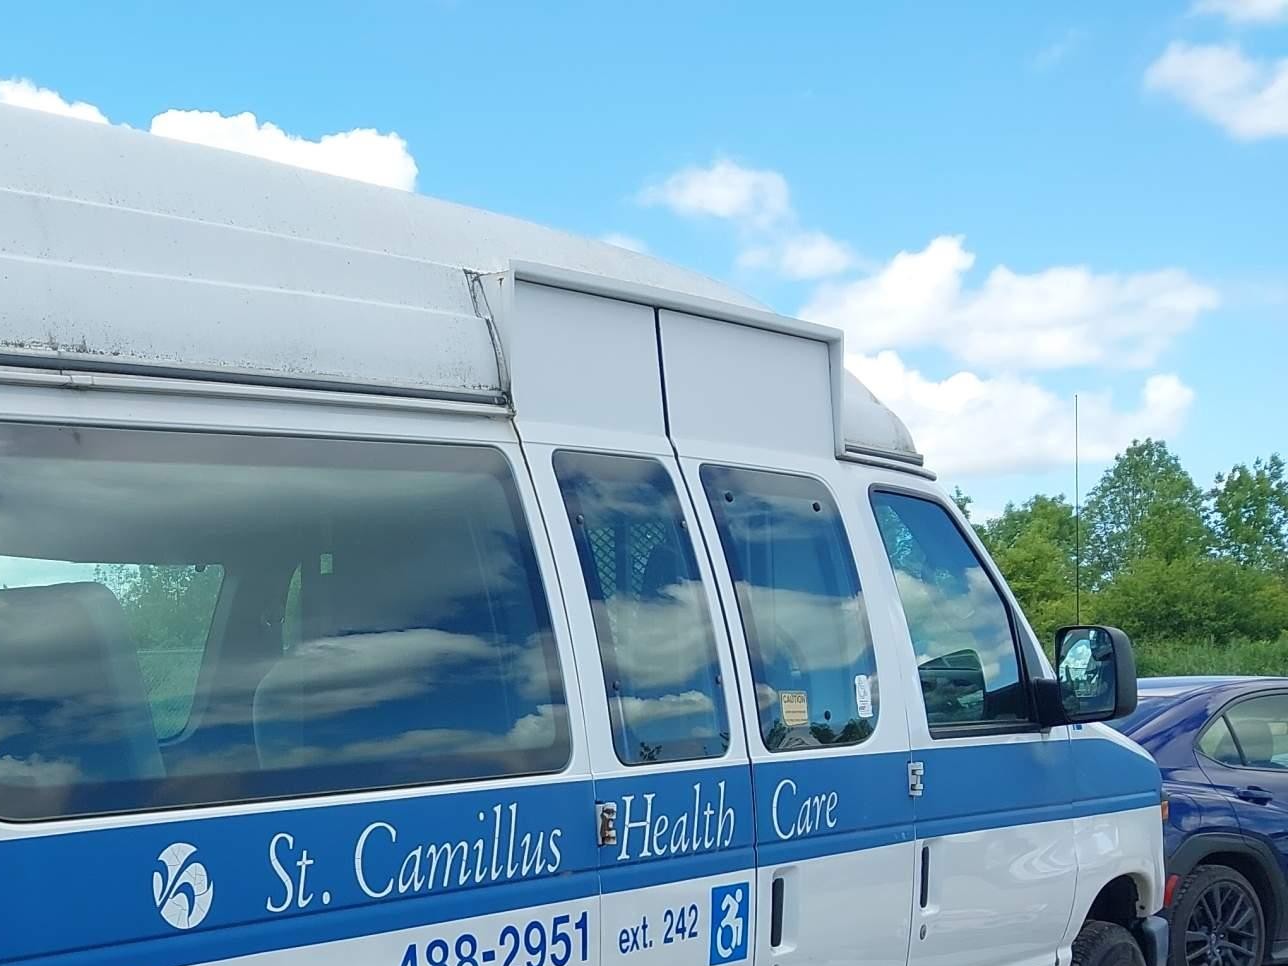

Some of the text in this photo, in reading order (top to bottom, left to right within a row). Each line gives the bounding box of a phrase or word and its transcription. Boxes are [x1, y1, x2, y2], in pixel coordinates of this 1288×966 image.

[782, 694, 806, 705] CAUTION
[266, 779, 839, 913] St. Camillus Health Care
[618, 915, 654, 954] ext.
[662, 903, 700, 945] 242
